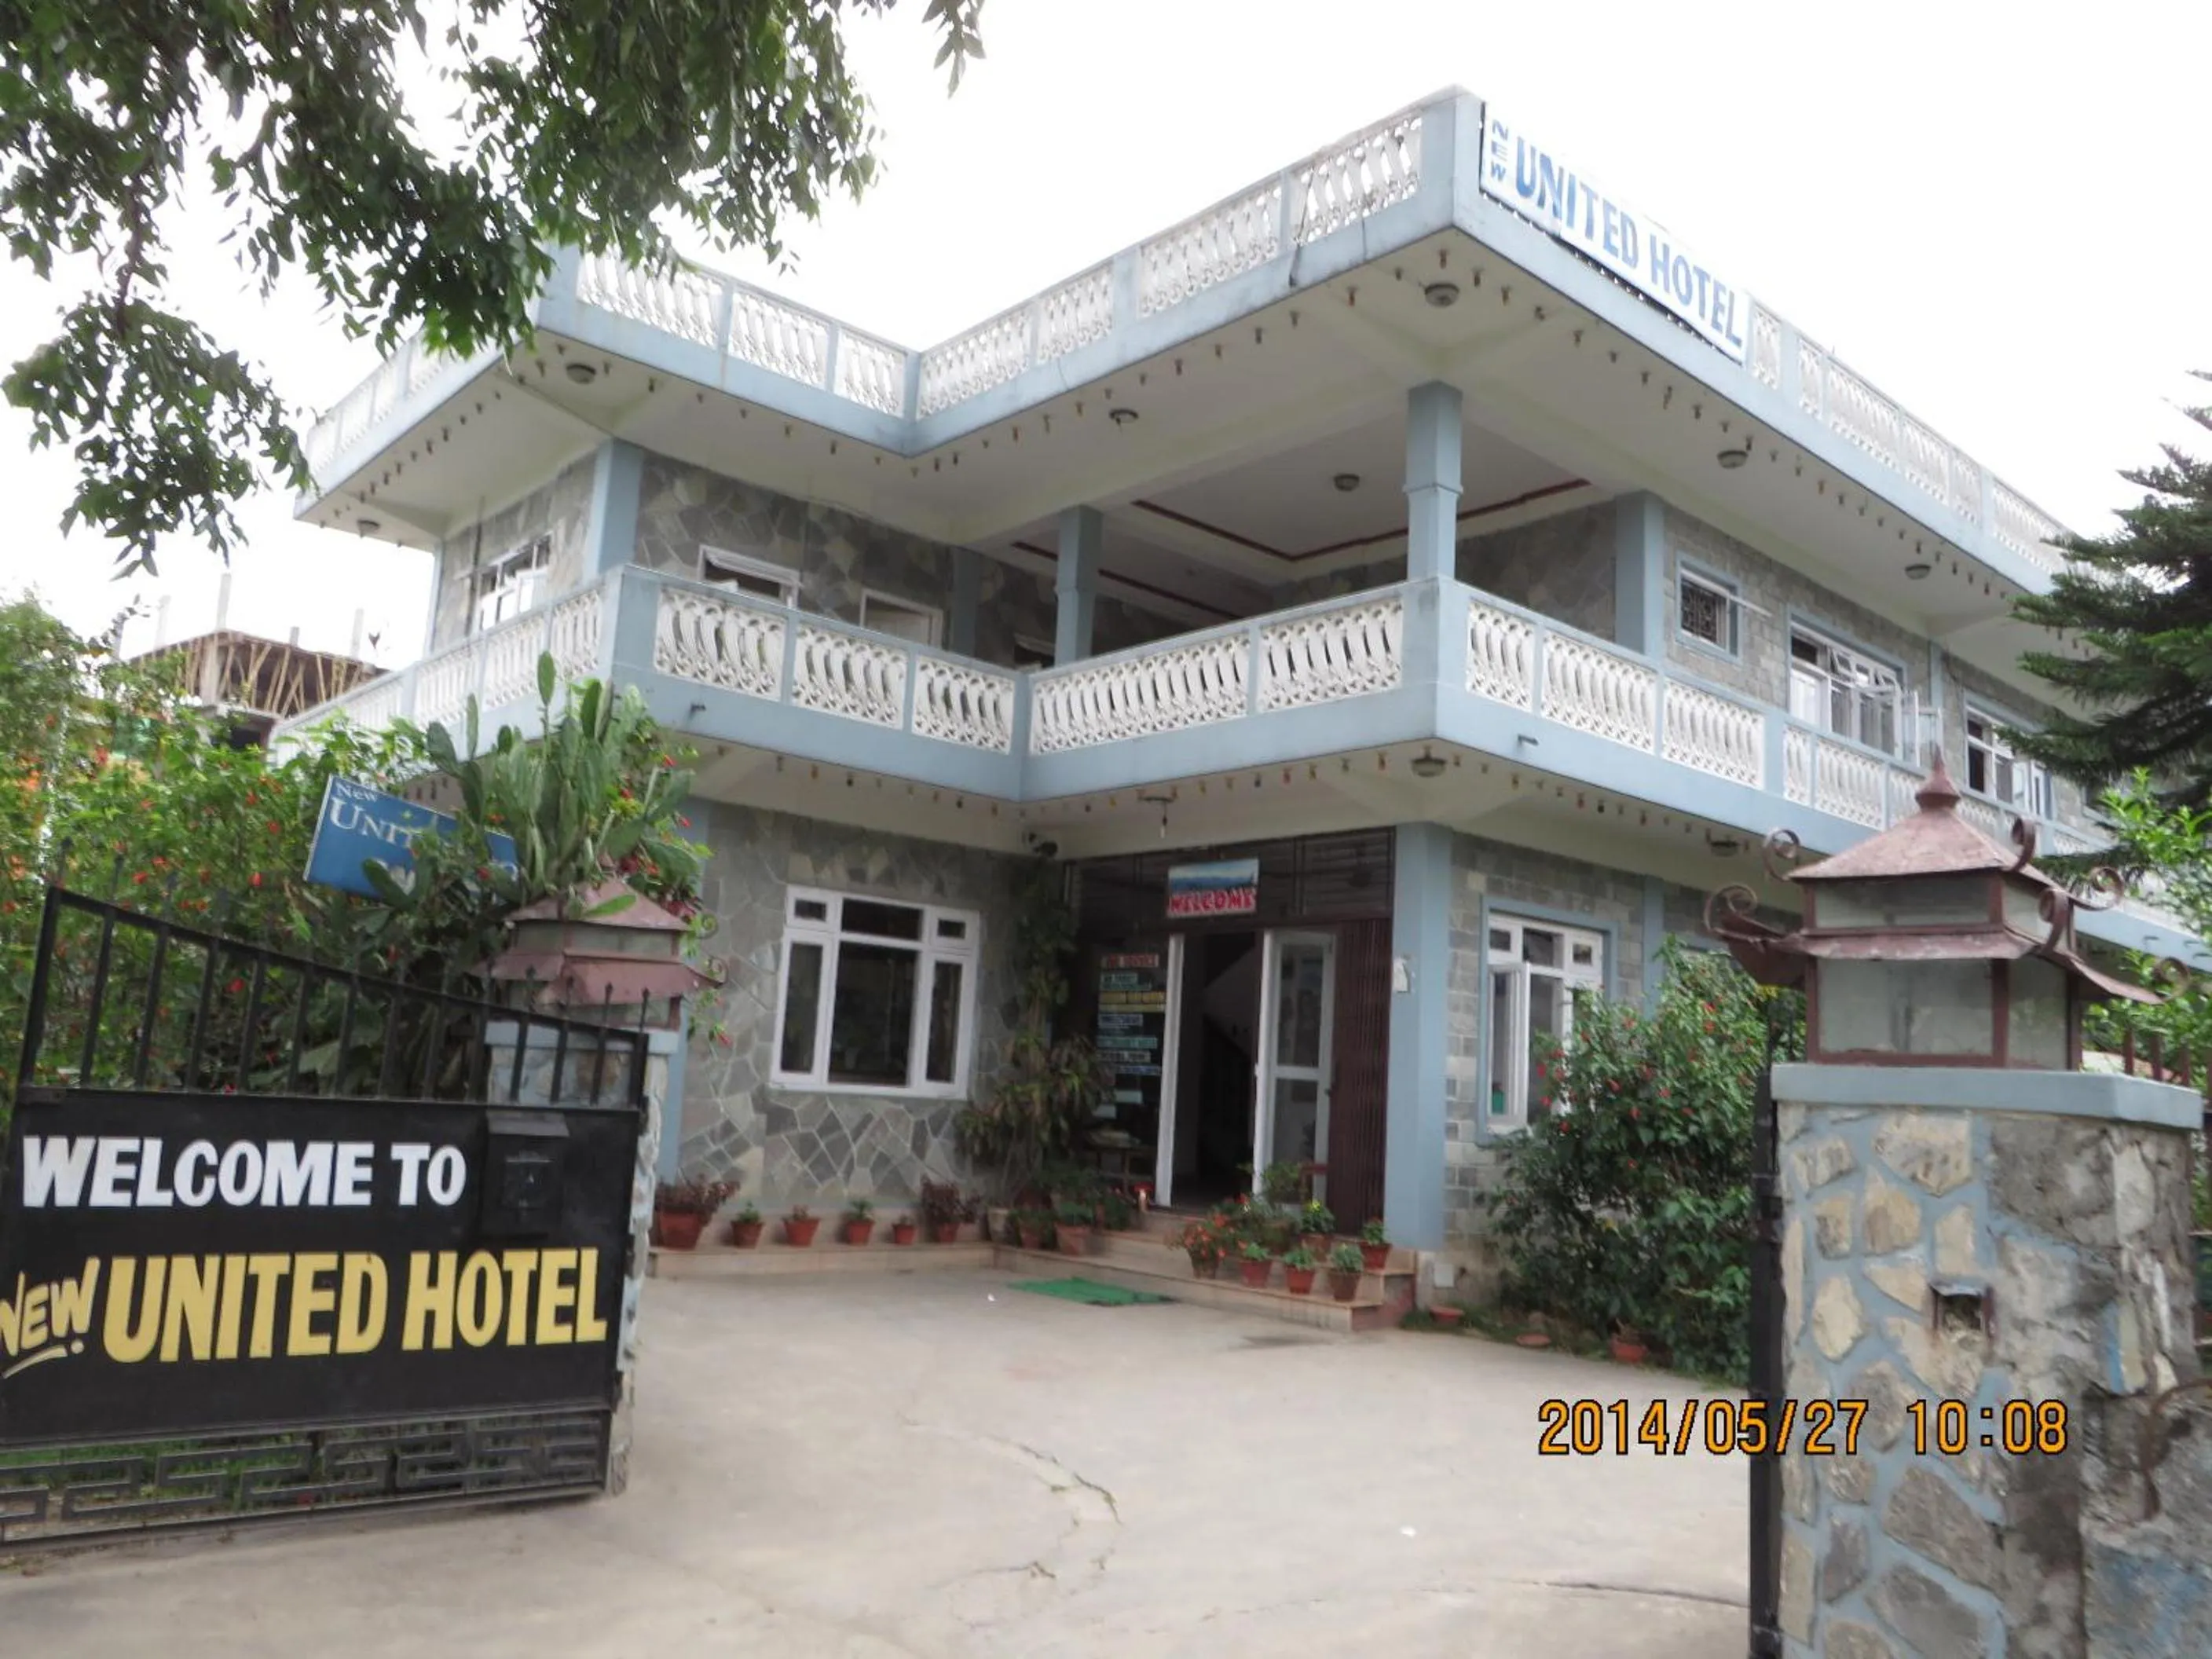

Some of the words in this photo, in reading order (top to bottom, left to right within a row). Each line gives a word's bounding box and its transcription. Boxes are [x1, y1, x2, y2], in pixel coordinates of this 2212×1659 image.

[1490, 119, 1509, 181] NEW
[1516, 136, 1639, 269] UNITED
[1650, 233, 1742, 348] HOTEL
[1170, 888, 1256, 914] WELCOME
[23, 1136, 375, 1207] WELCOME
[391, 1142, 467, 1206] TO
[0, 1255, 101, 1357] NEW
[103, 1252, 389, 1364] UNITED
[401, 1247, 608, 1351] HOTEL
